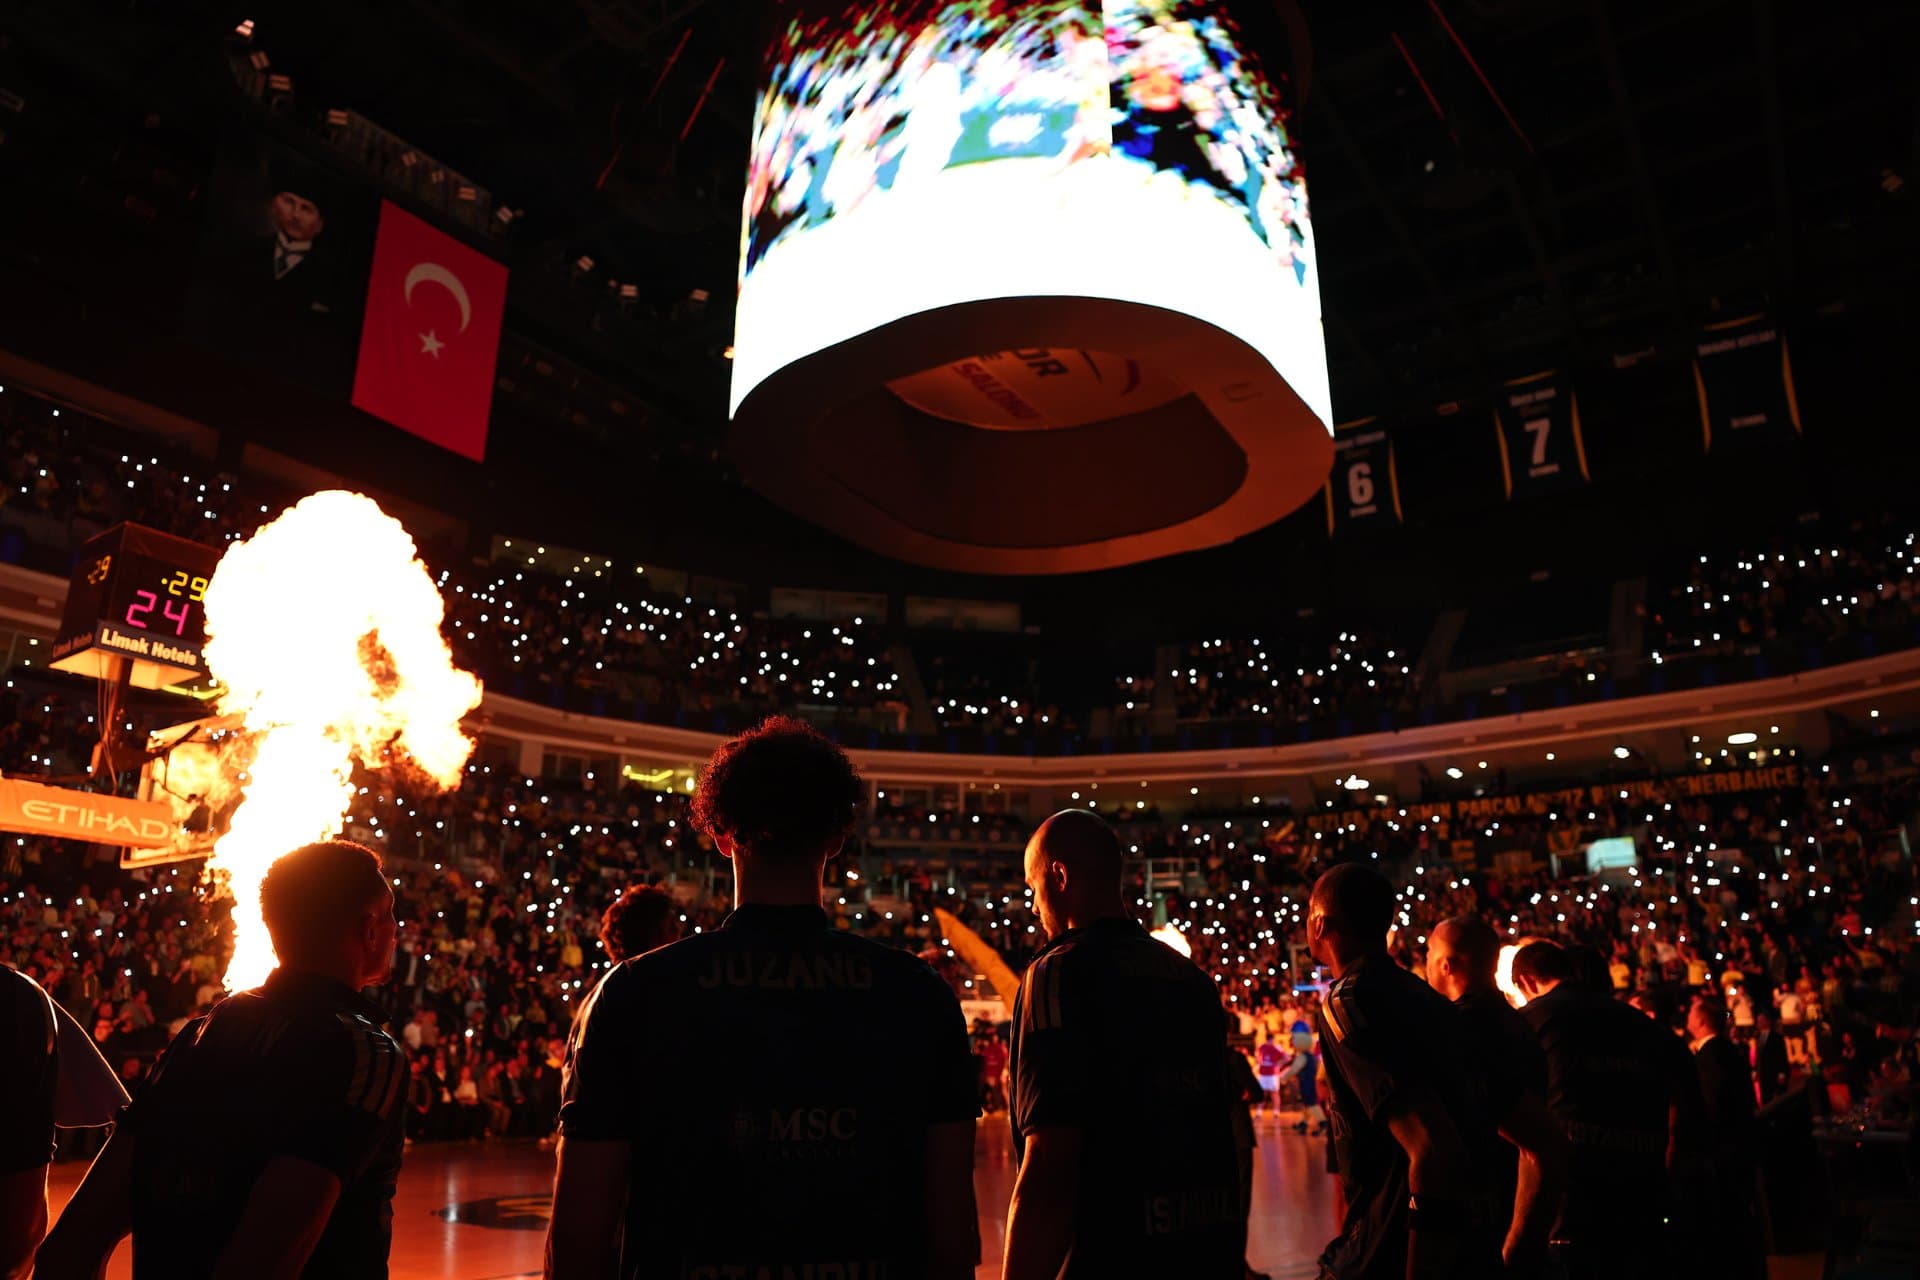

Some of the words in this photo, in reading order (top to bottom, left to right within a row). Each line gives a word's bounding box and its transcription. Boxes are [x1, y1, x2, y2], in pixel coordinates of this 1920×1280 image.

[1520, 416, 1552, 466] 7
[1347, 460, 1376, 507] 6
[125, 588, 191, 637] 24
[100, 626, 150, 656] Limak
[150, 641, 198, 667] Hotels
[21, 799, 170, 840] ETIHAD
[697, 950, 873, 991] JUZANG
[767, 1106, 858, 1142] MSC
